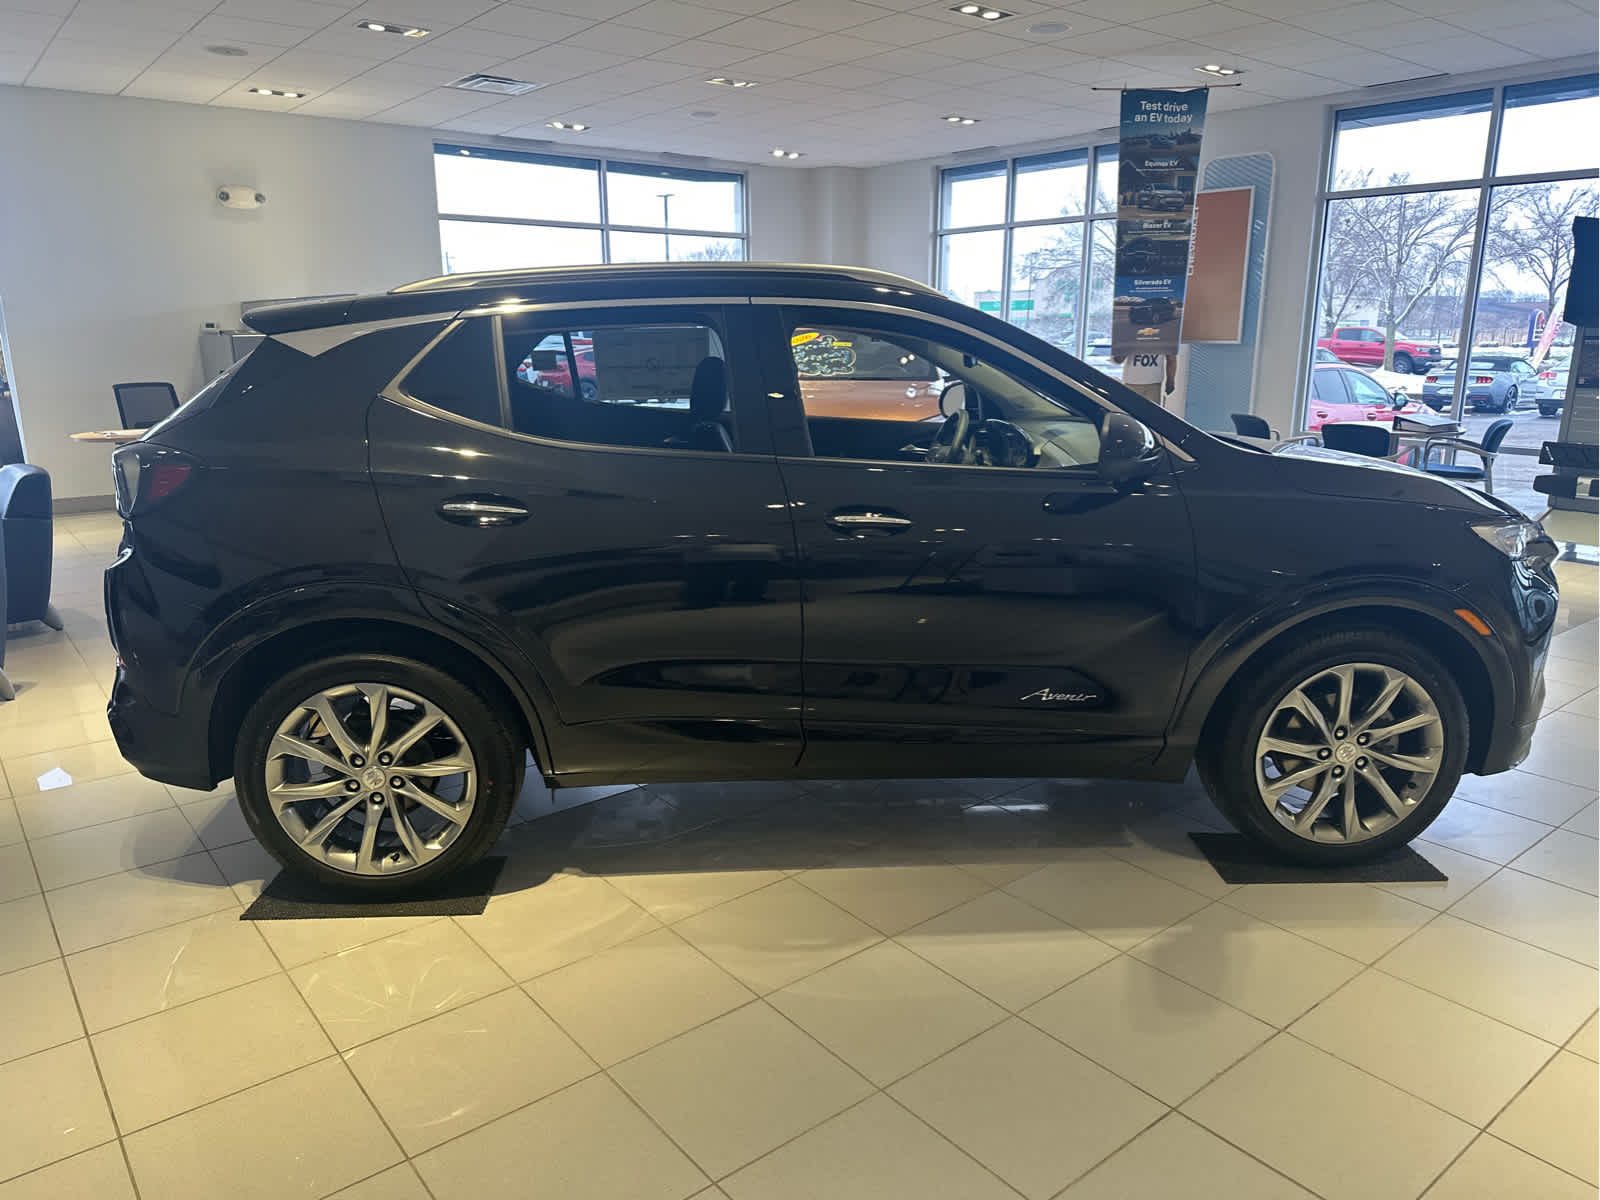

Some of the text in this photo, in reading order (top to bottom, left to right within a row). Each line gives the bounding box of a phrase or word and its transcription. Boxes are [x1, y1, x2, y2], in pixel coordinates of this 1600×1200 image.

[1140, 100, 1188, 112] Test drive
[1134, 112, 1193, 124] an EV today
[1133, 354, 1159, 367] FOX
[1020, 687, 1097, 702] Avenir
